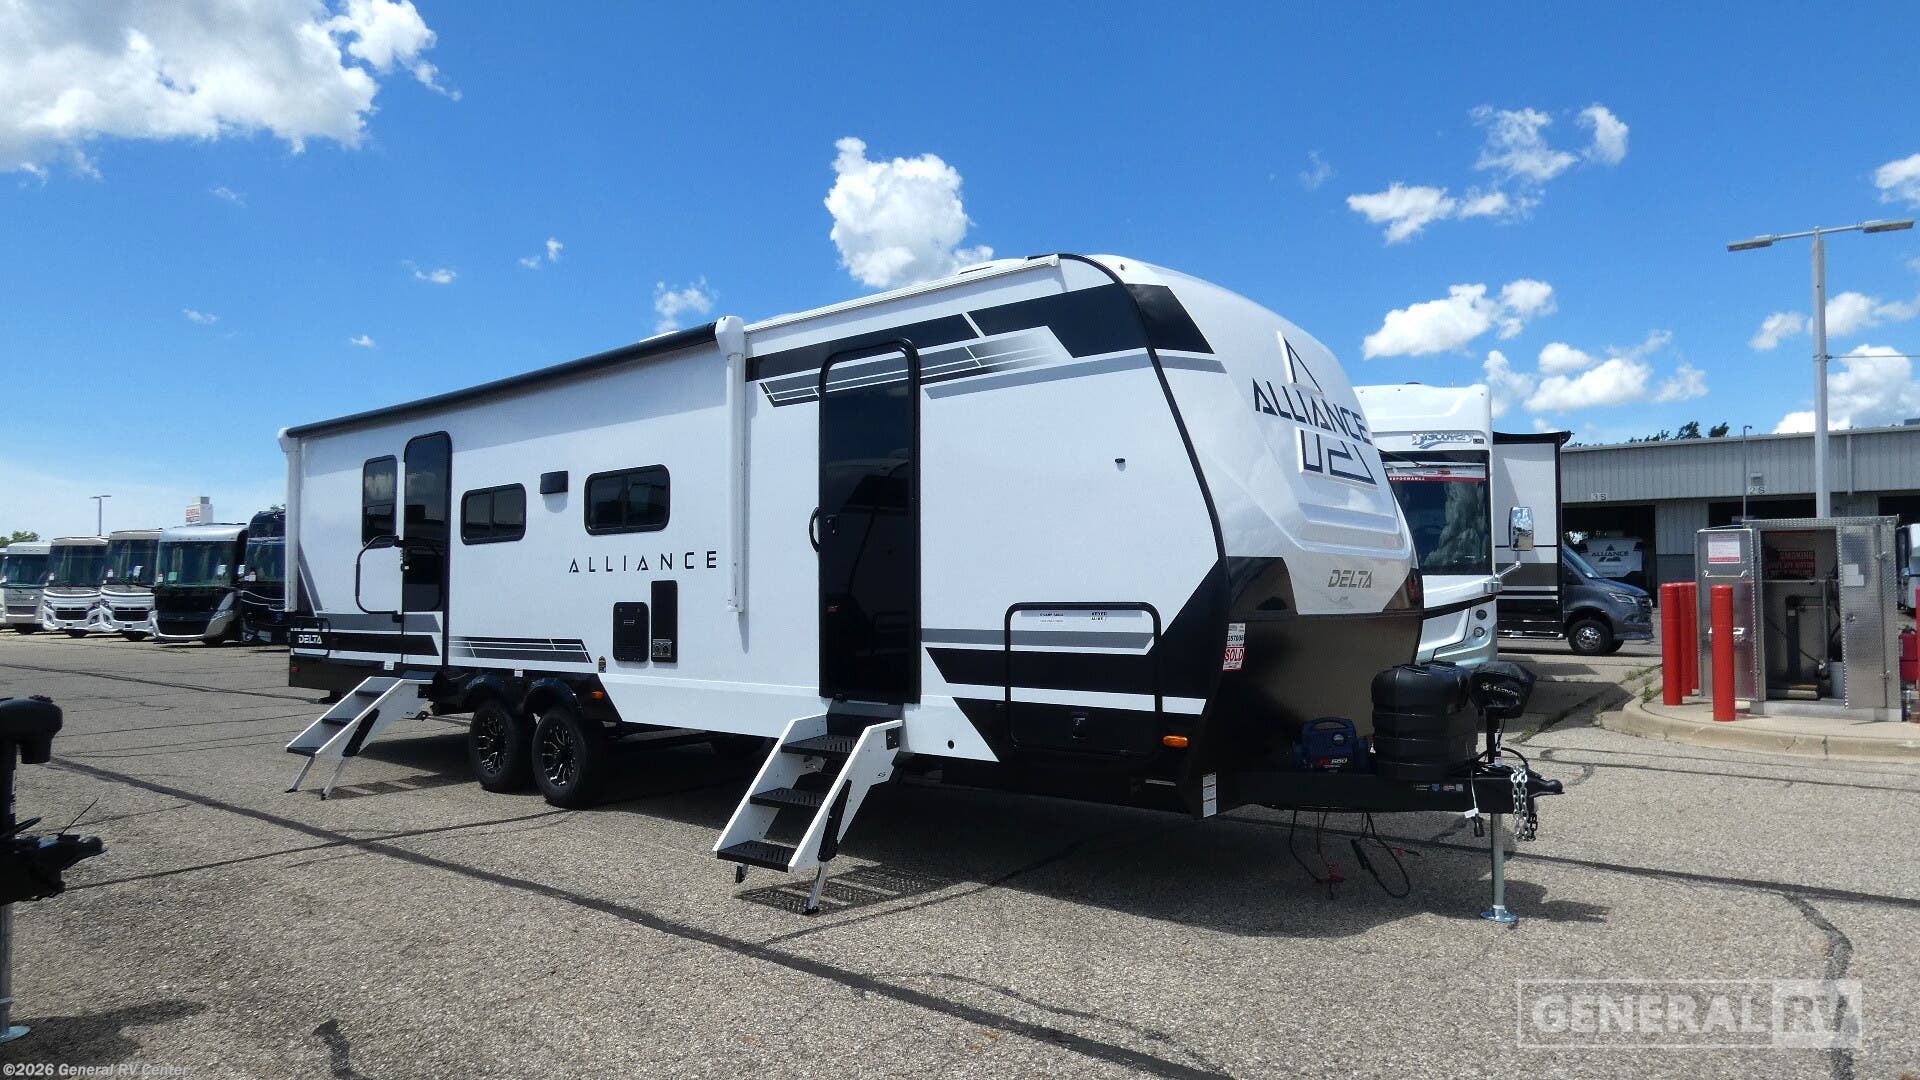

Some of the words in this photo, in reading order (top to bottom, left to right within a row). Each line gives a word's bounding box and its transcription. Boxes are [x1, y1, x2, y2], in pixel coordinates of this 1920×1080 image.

[1252, 377, 1373, 445] ALLIANCE
[568, 550, 717, 573] ALLIANCE
[1592, 549, 1631, 557] ALLIANCE
[1327, 569, 1373, 589] DELTA
[298, 634, 323, 644] DELTA
[1225, 648, 1244, 662] SOLD
